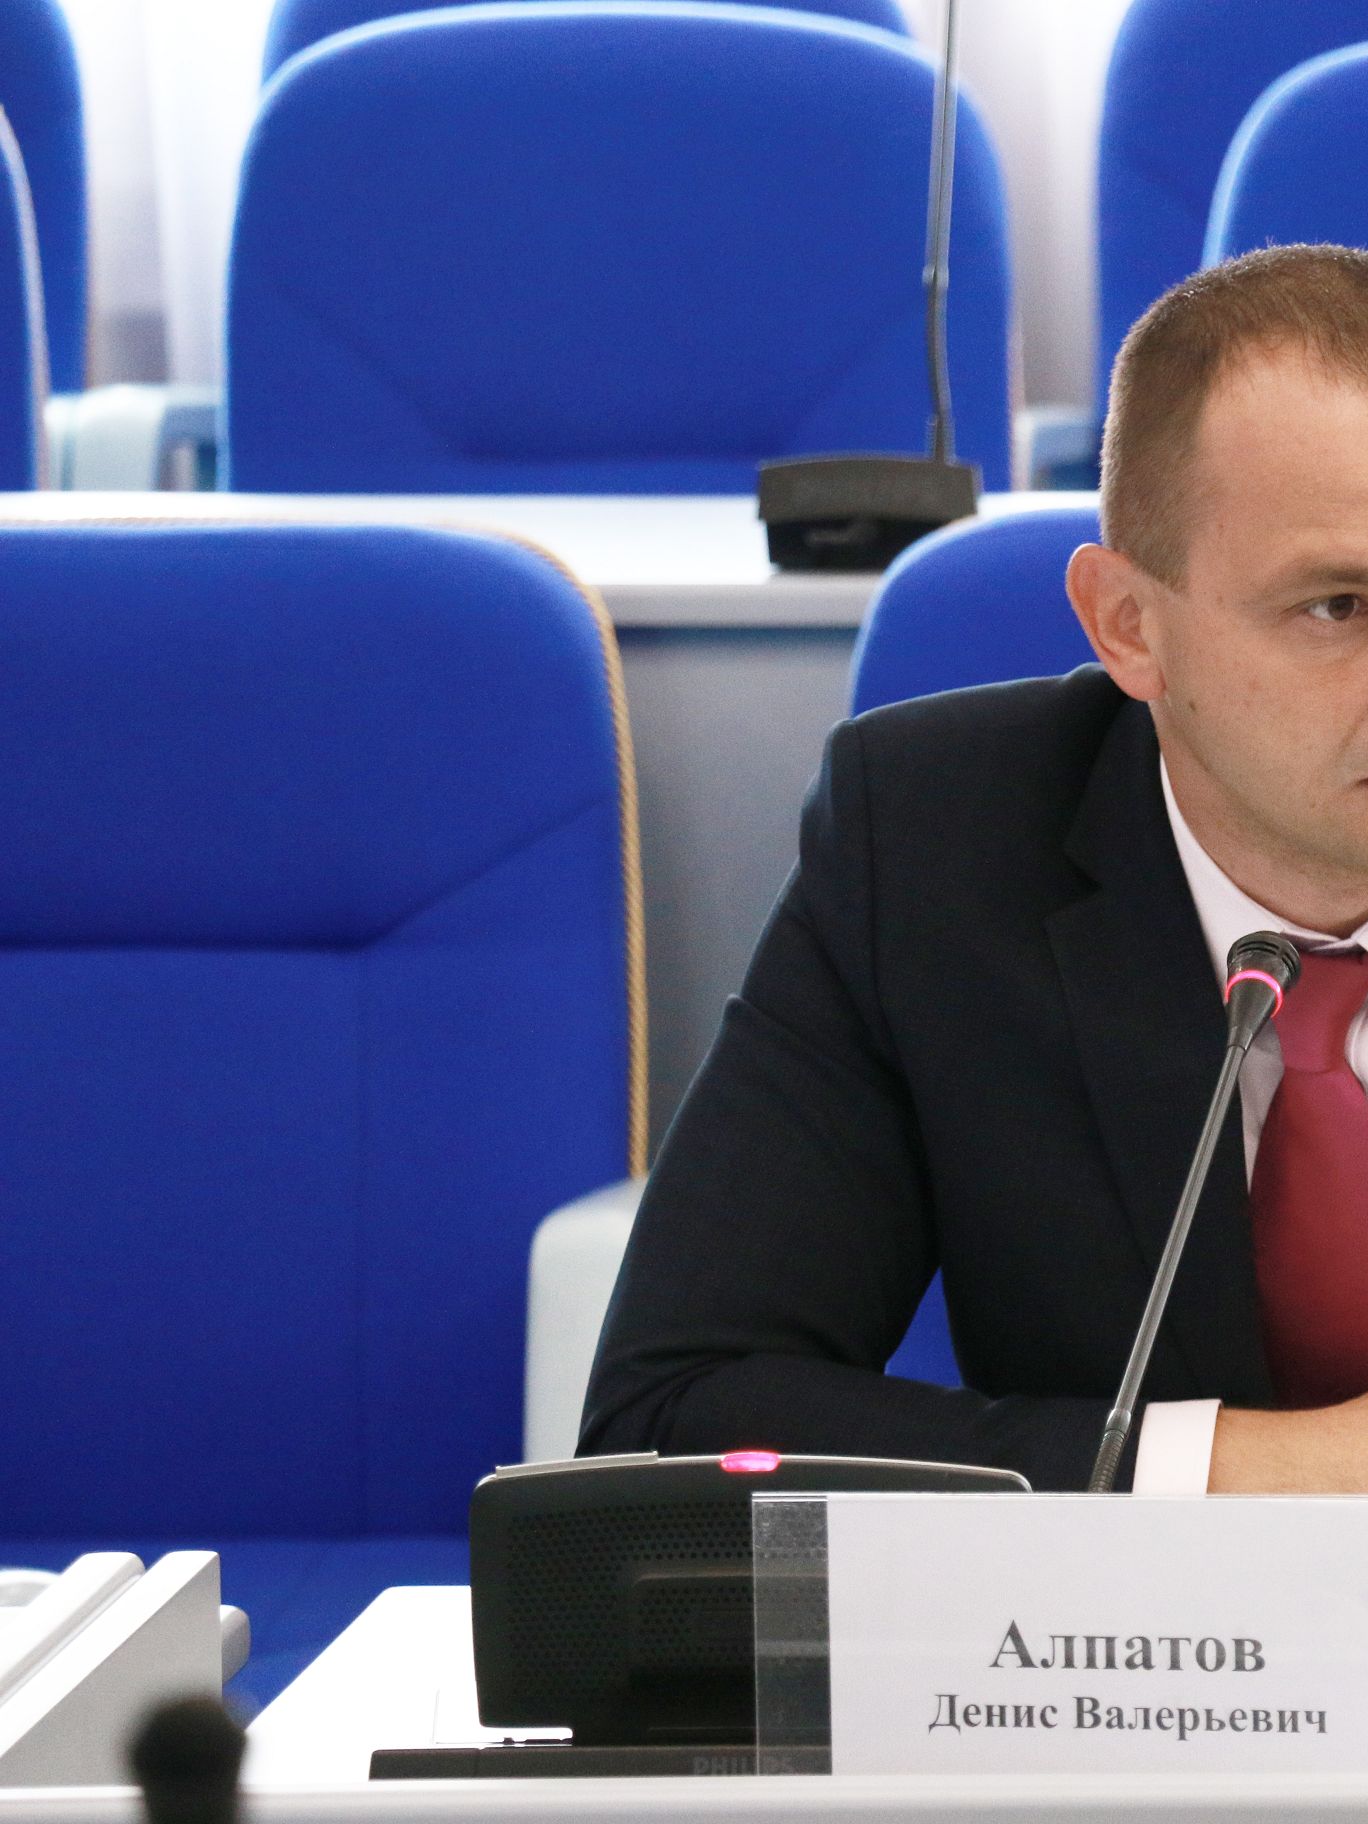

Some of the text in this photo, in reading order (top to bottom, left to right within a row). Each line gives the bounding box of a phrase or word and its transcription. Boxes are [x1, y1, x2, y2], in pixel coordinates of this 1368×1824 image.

[988, 1619, 1266, 1673] Алпатов
[928, 1694, 1327, 1741] Денис Валерьевич
[693, 1755, 796, 1775] PHILPS
